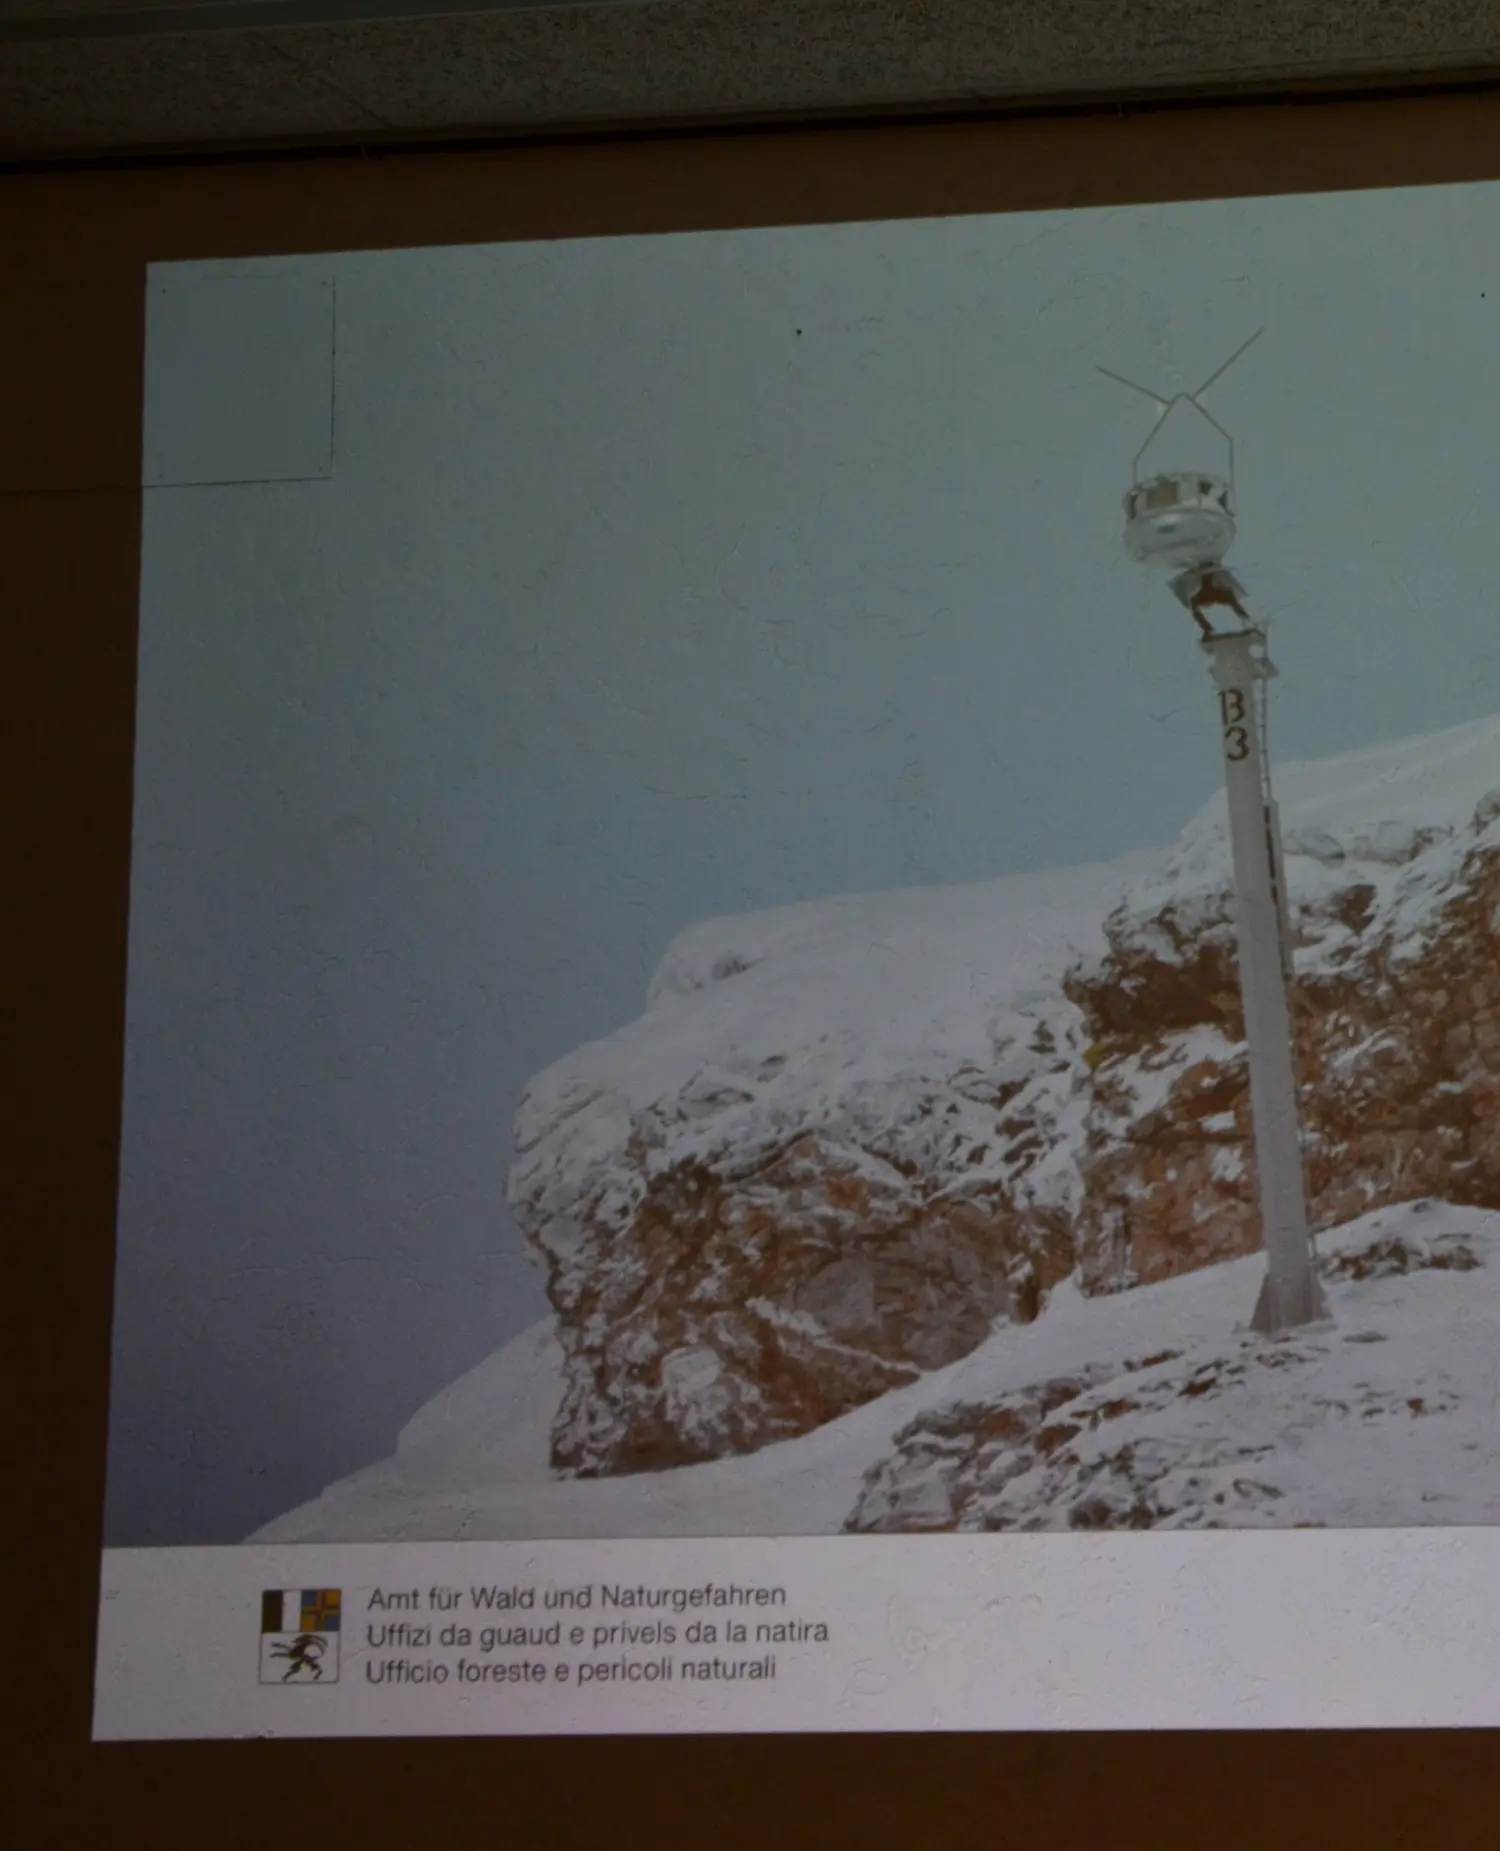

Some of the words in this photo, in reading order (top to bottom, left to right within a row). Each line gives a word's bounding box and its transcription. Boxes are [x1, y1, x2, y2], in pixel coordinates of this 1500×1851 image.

[367, 1586, 420, 1611] Amt
[428, 1586, 464, 1610] für
[470, 1585, 535, 1610] Wald
[543, 1585, 593, 1609] und
[601, 1584, 786, 1613] Naturgefahren
[367, 1623, 431, 1648] Uffizi
[439, 1622, 473, 1647] da
[479, 1622, 561, 1653] guaud
[568, 1627, 584, 1646] e
[592, 1620, 677, 1650] privels
[685, 1620, 719, 1646] da
[726, 1619, 749, 1645] la
[754, 1618, 830, 1645] natira
[366, 1659, 449, 1685] Ufficio
[456, 1659, 548, 1684] foreste
[554, 1664, 571, 1684] e
[577, 1656, 673, 1687] pericoli
[680, 1655, 777, 1681] naturali
